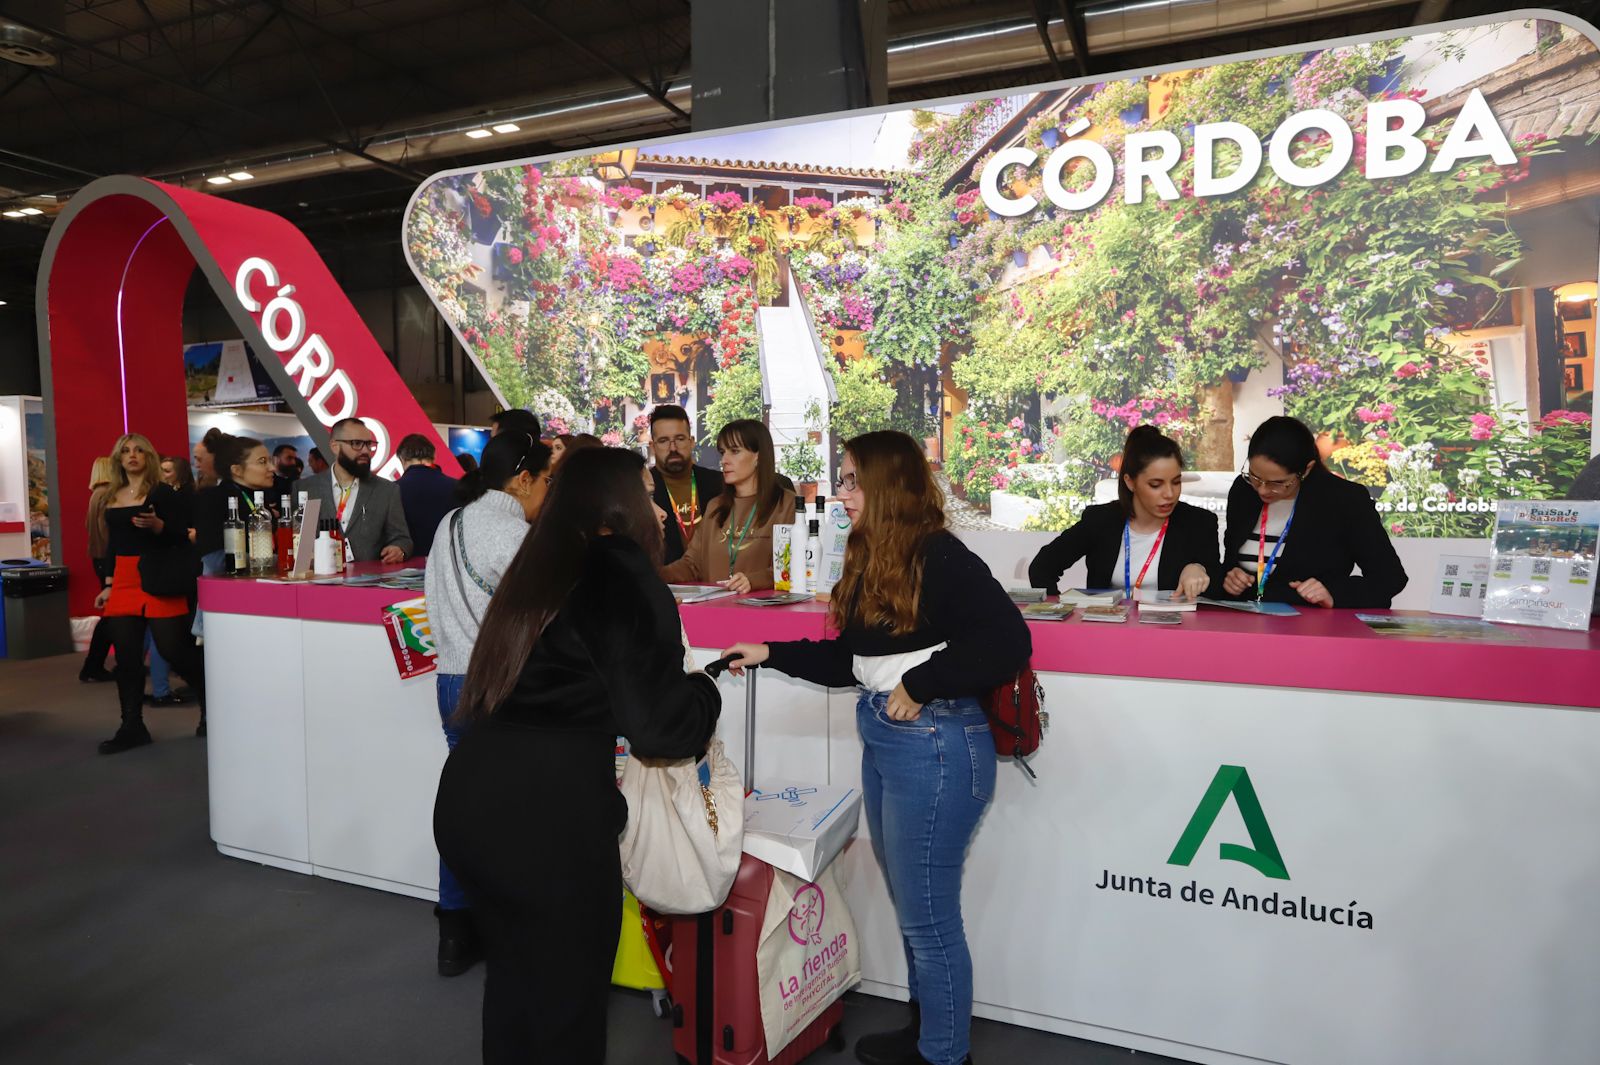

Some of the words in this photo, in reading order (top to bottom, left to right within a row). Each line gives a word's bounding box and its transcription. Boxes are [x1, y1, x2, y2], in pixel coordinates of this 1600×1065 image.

[979, 86, 1518, 218] CÓRDOBA
[1396, 496, 1418, 512] de
[1095, 869, 1172, 899] Junta
[1180, 880, 1215, 905] de
[1221, 886, 1373, 930] Andalucía
[779, 975, 799, 1000] La
